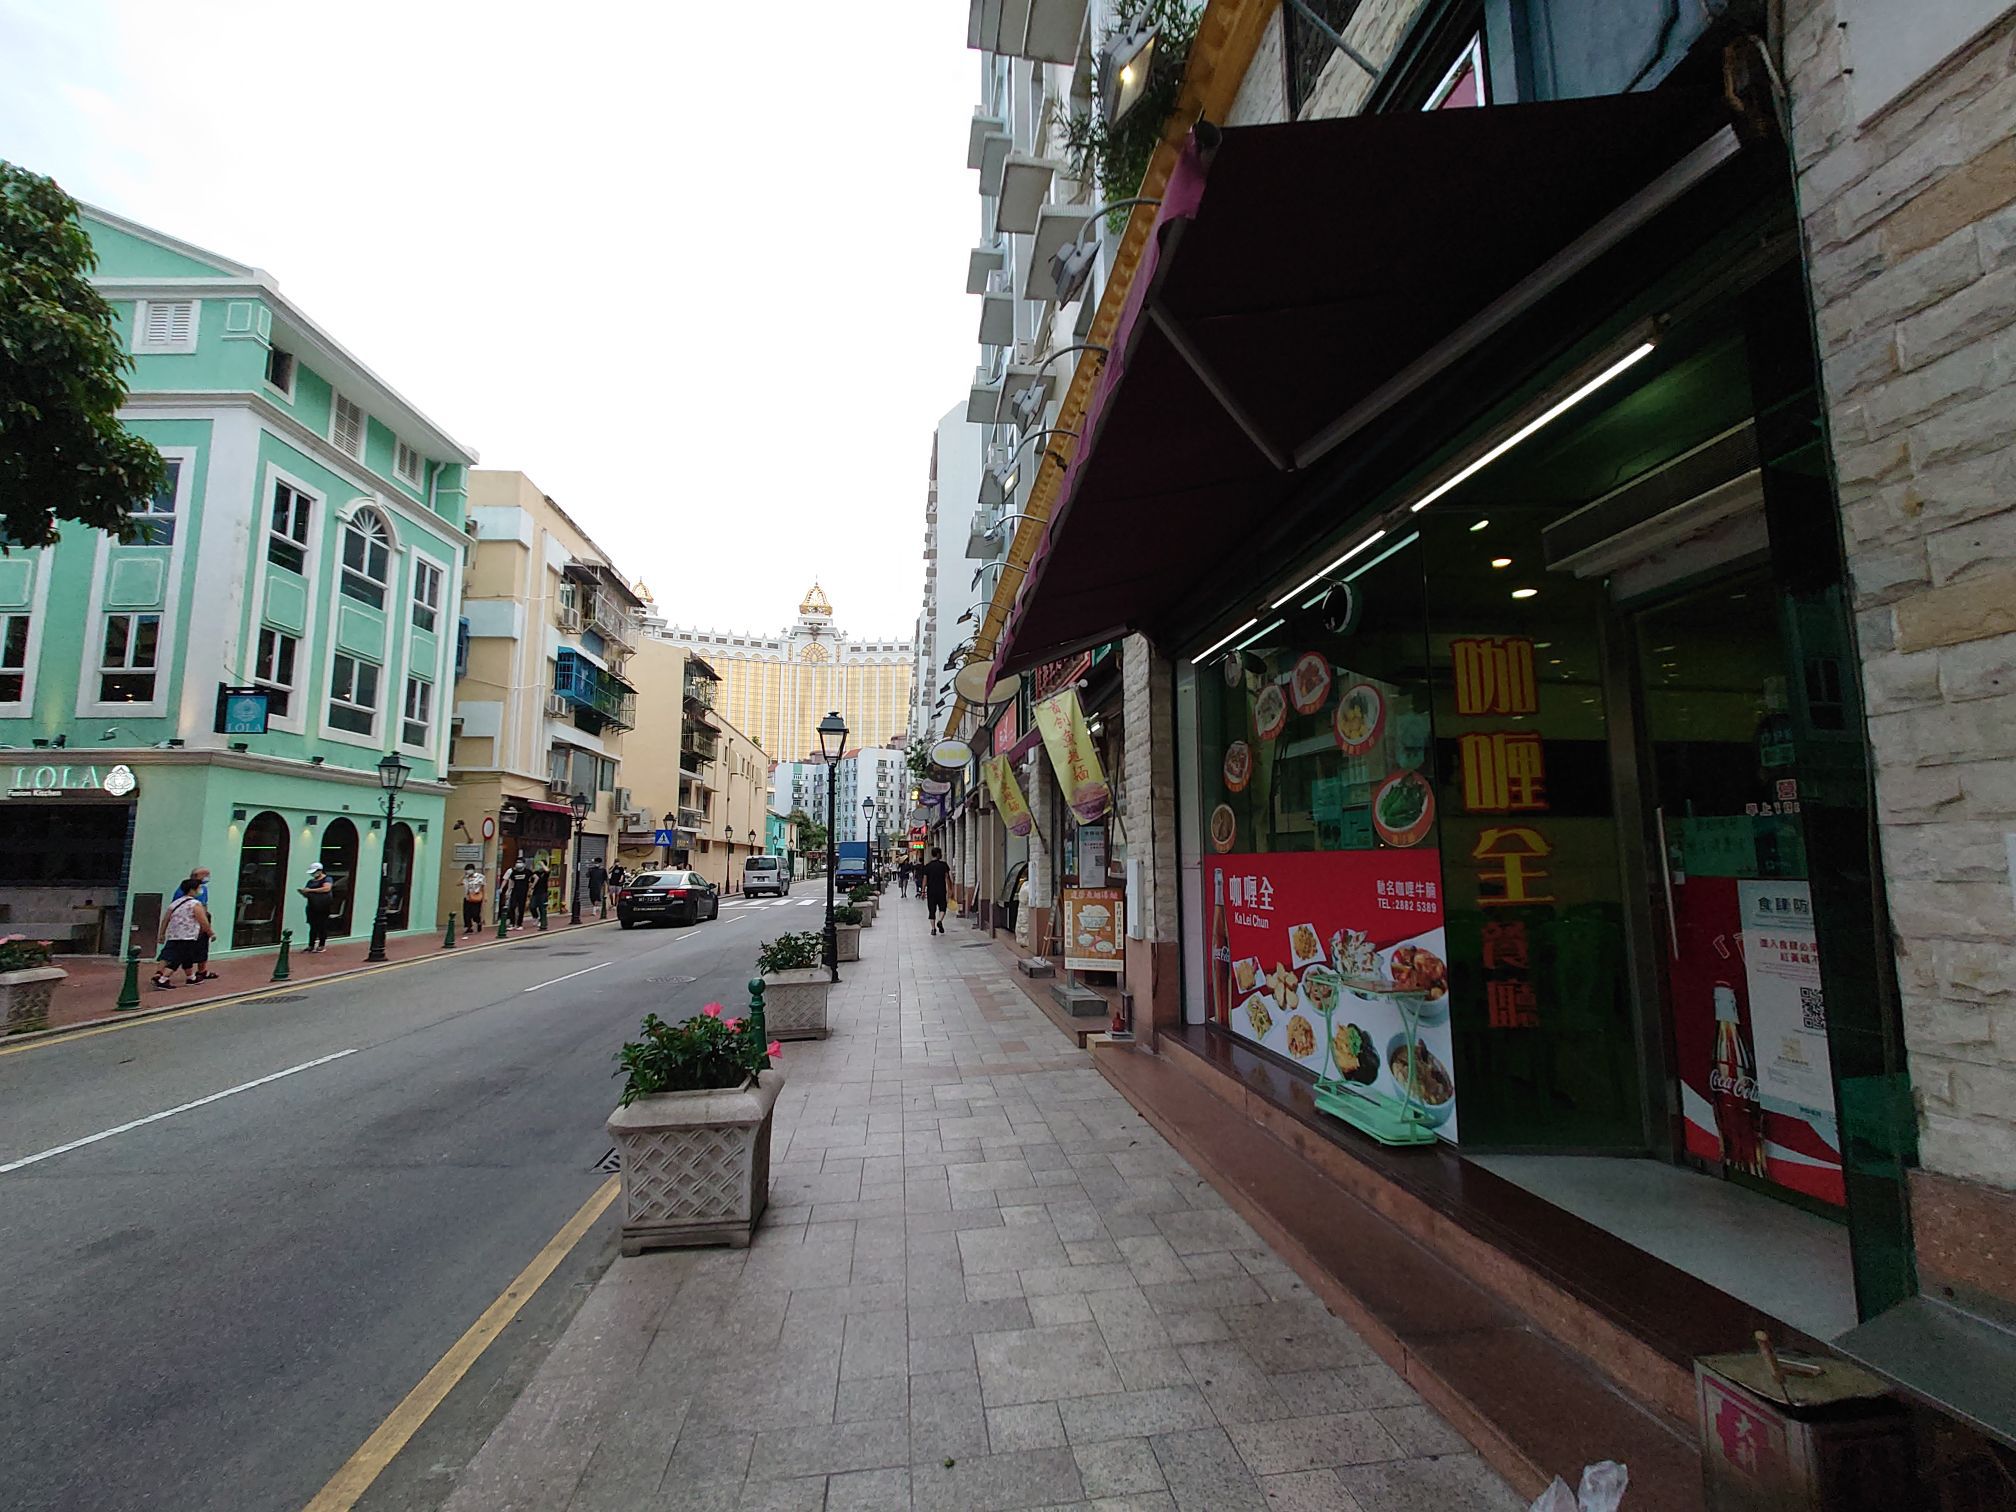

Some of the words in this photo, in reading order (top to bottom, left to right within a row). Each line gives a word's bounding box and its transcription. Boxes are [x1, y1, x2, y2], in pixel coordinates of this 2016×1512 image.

[13, 765, 101, 789] LOLA
[1234, 911, 1243, 925] Ka
[1243, 913, 1252, 927] Lei
[1252, 914, 1270, 929] Chun
